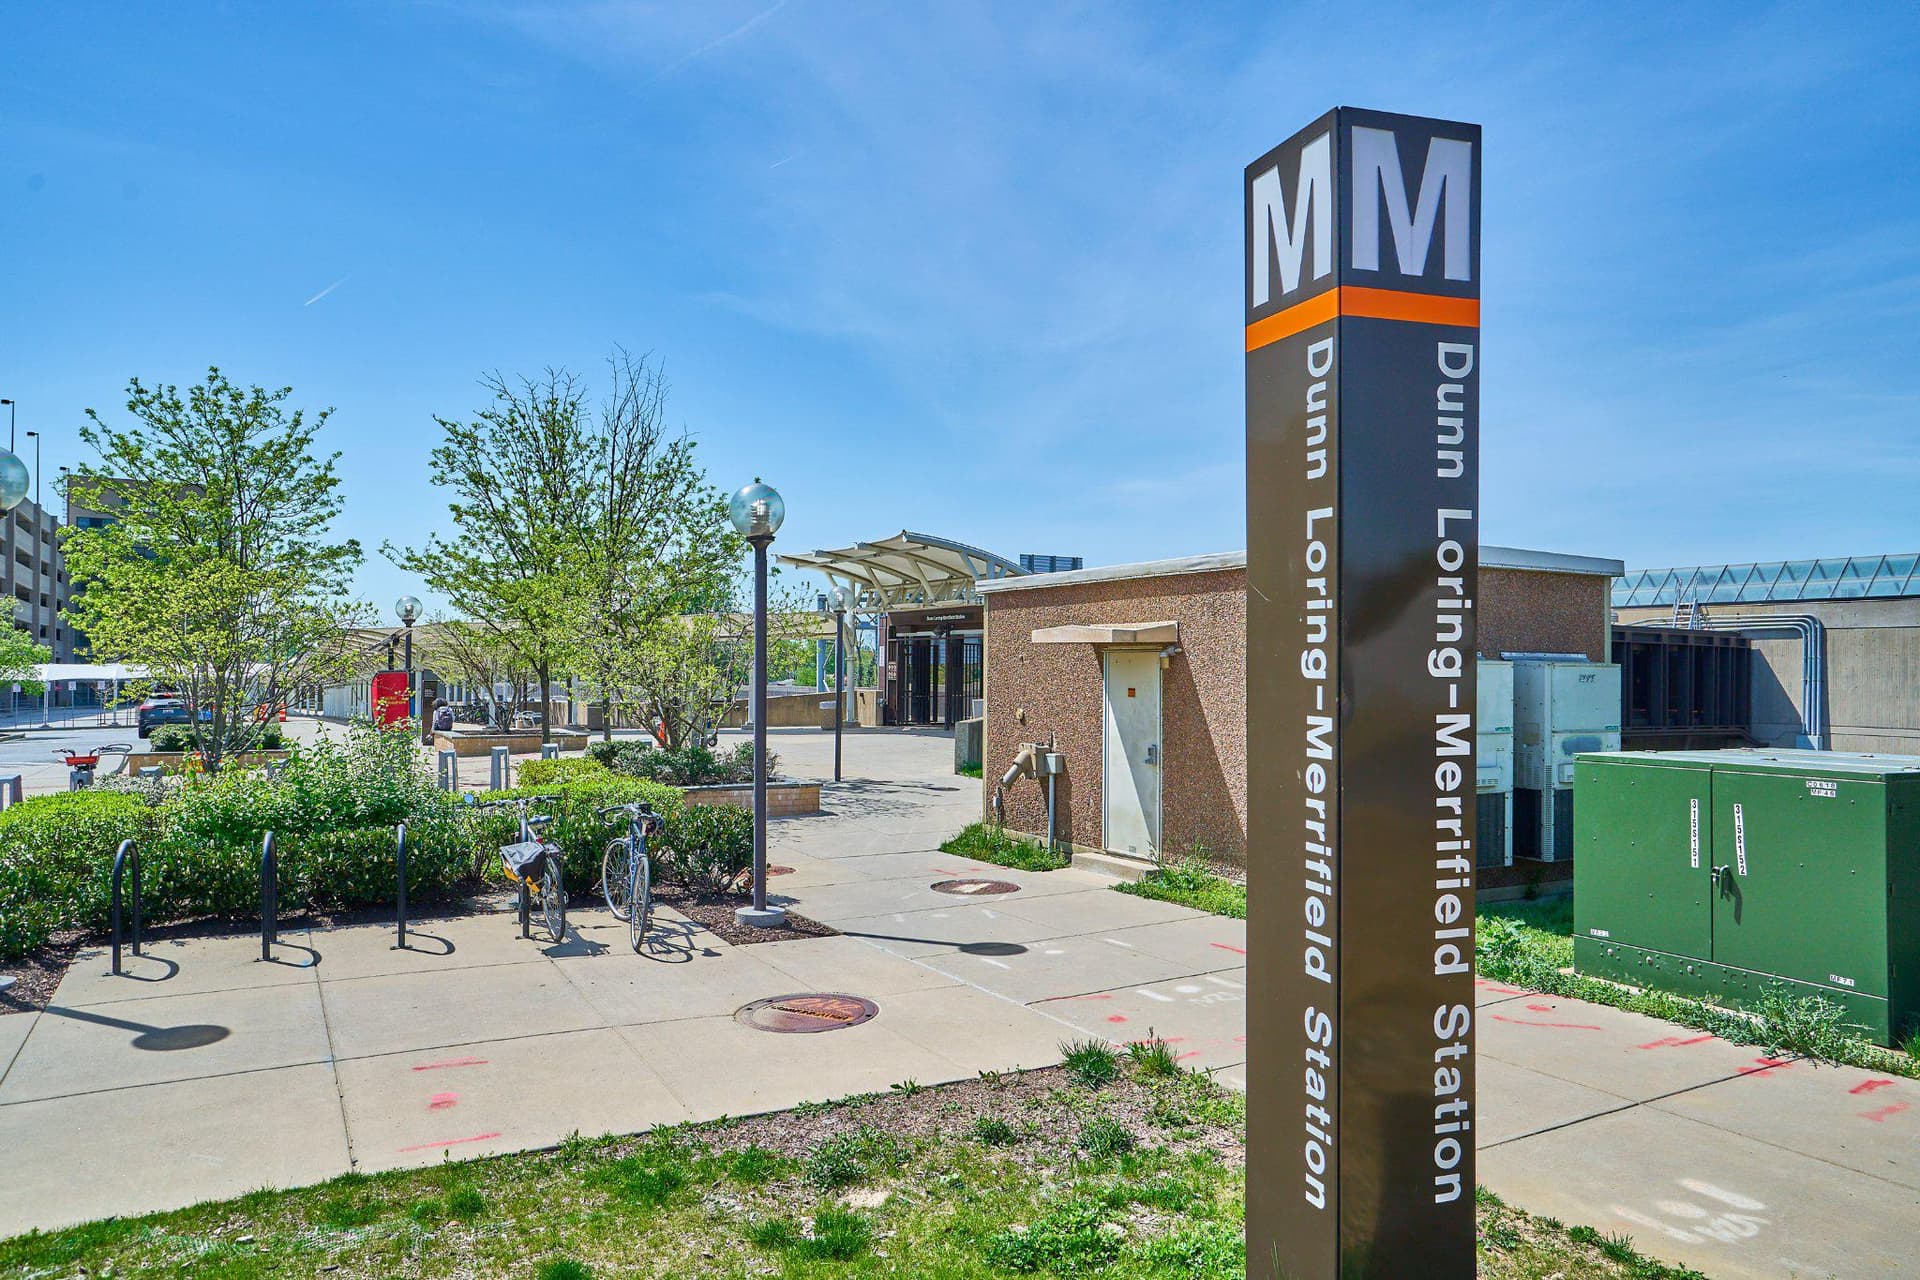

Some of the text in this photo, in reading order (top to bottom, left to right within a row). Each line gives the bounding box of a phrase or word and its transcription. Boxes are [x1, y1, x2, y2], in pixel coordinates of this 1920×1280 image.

[1253, 131, 1331, 308] M
[1352, 125, 1472, 282] M
[1301, 337, 1333, 1210] Dunn Loring-Merrifield Station
[1427, 342, 1473, 1204] Dunn Loring-Merrifield Station
